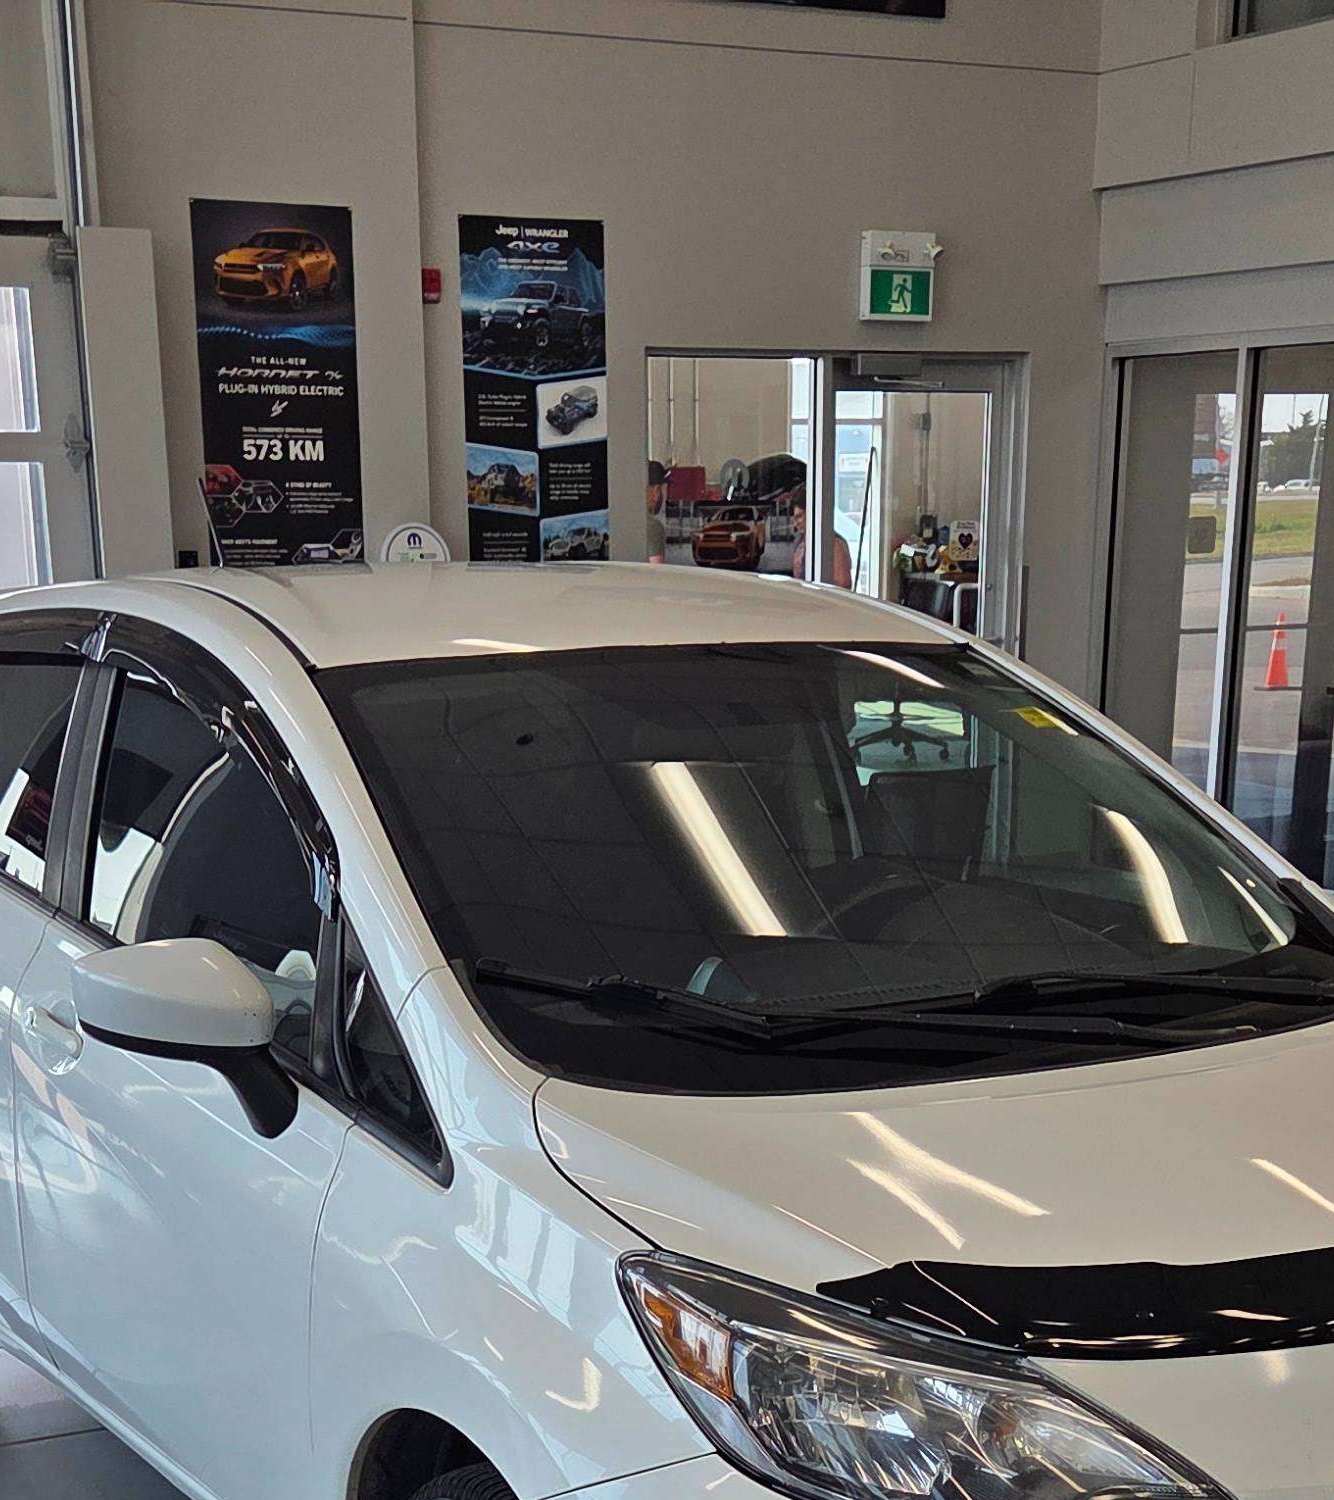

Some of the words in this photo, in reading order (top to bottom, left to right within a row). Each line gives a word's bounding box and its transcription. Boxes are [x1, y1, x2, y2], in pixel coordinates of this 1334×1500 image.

[495, 224, 519, 238] Jeep
[524, 227, 569, 239] WRANGLER
[251, 355, 267, 366] THE
[218, 383, 259, 395] PLUG-IN
[260, 384, 298, 396] HYBRID
[299, 385, 344, 397] ELECTRIC
[242, 438, 283, 462] 573
[288, 439, 325, 463] KM
